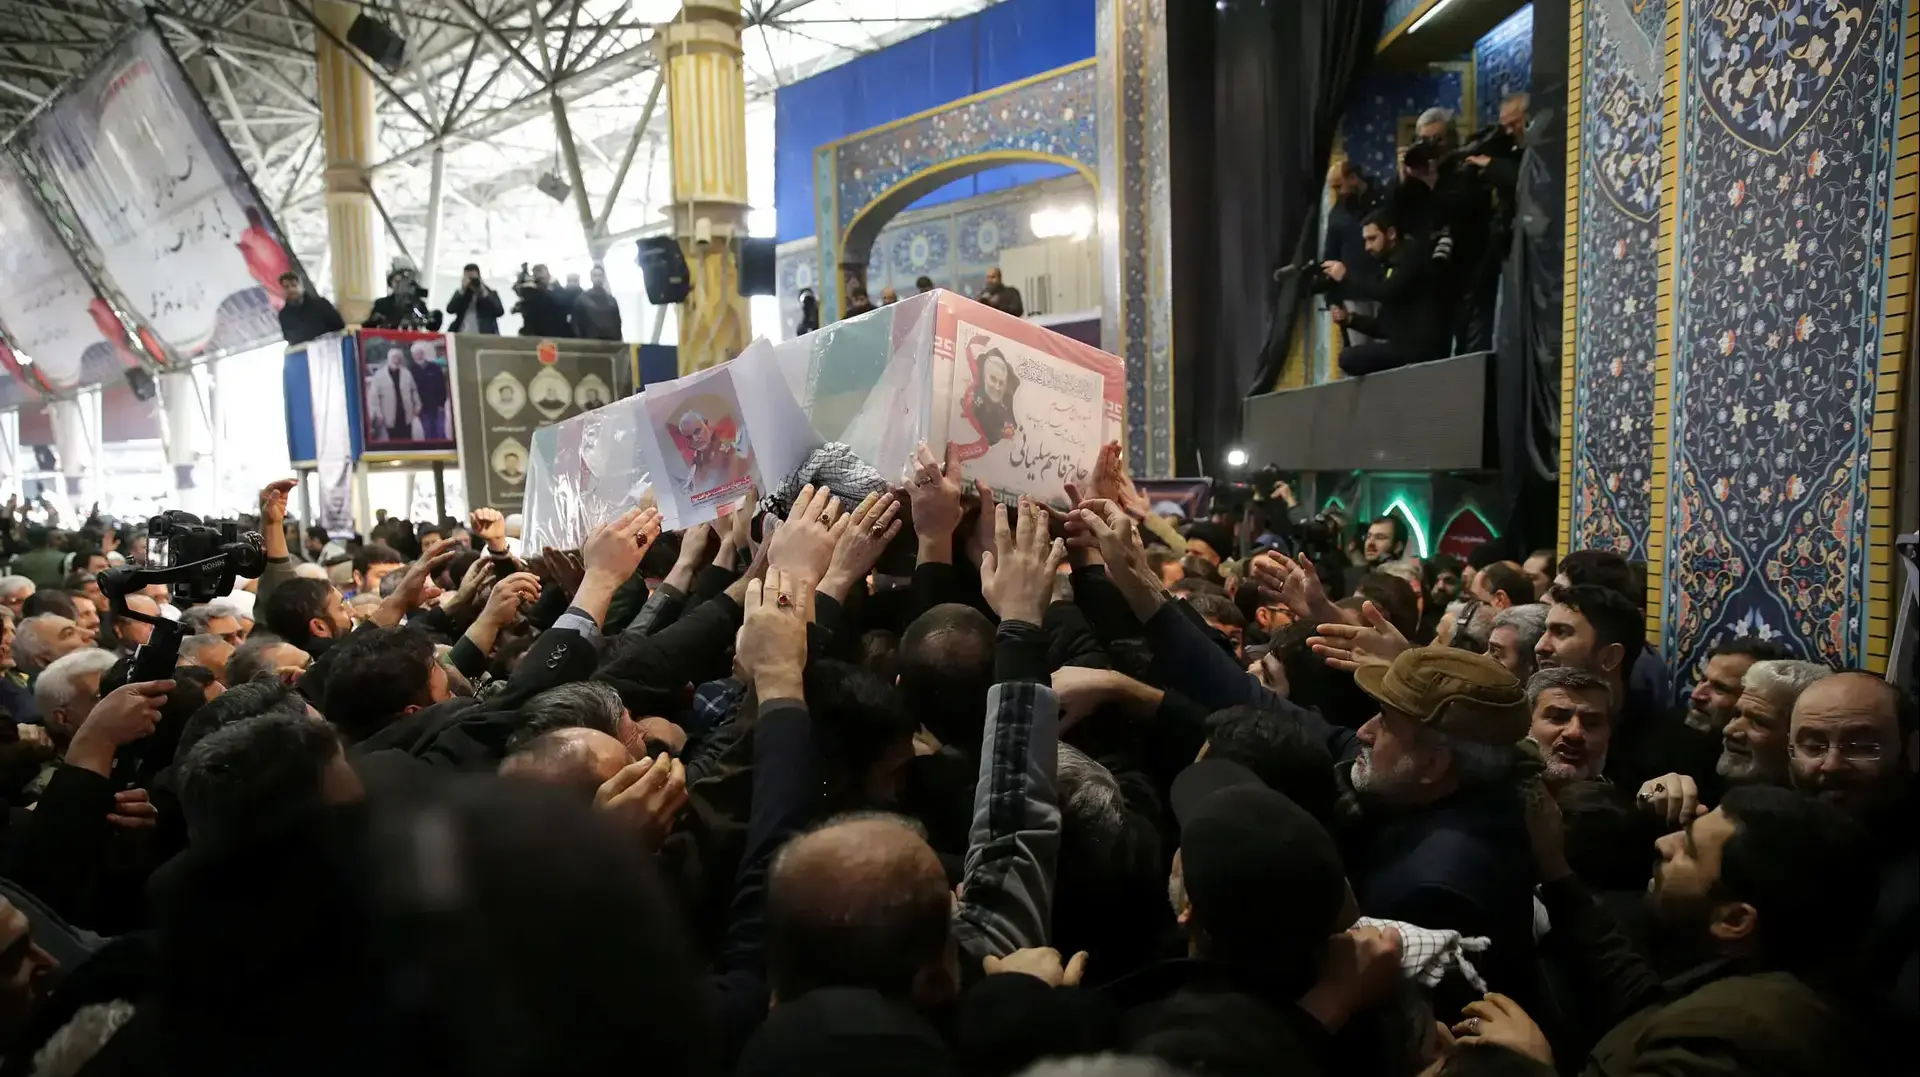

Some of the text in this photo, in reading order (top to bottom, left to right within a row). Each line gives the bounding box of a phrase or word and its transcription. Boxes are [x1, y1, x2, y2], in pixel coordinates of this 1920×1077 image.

[1009, 425, 1052, 481] سلیمانی
[1041, 453, 1071, 480] قاسم
[1063, 457, 1089, 484] حاج
[202, 559, 225, 571] RONIN
